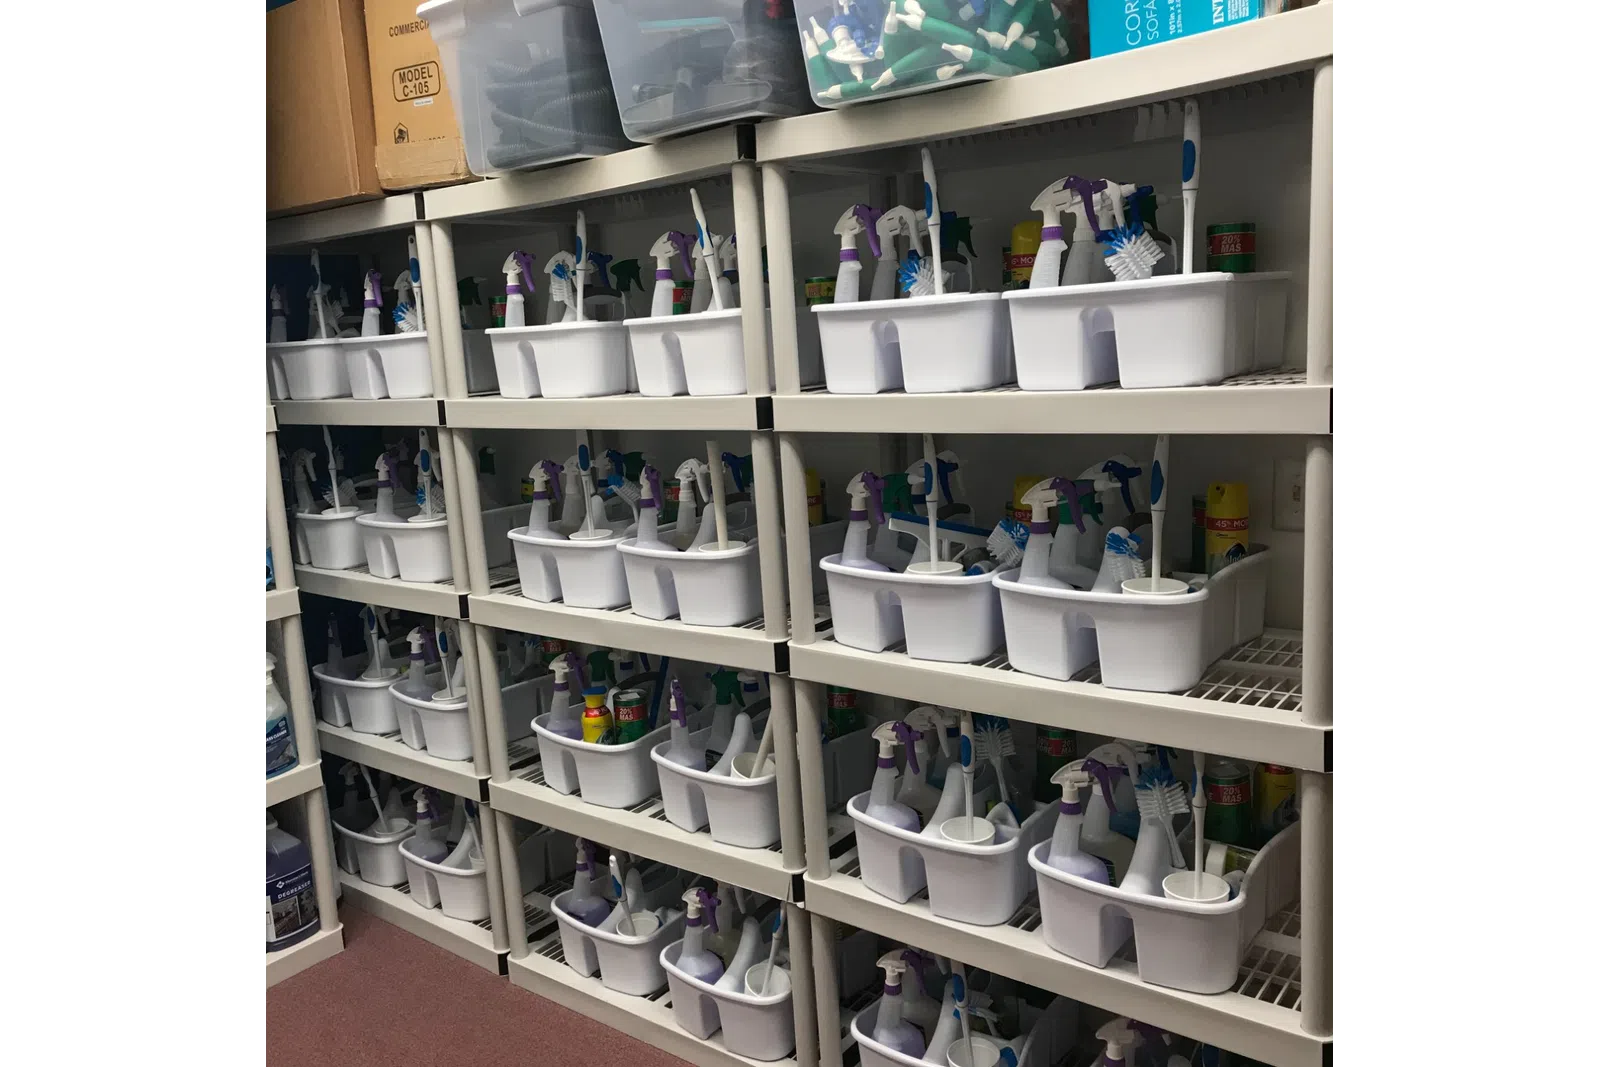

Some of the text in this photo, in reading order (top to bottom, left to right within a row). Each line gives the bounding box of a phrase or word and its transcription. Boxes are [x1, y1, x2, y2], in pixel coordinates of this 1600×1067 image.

[1125, 0, 1142, 45] COR
[398, 66, 433, 84] MODEL
[402, 81, 430, 97] C-105
[1221, 235, 1241, 245] 20%
[1220, 243, 1242, 253] MAS
[1020, 257, 1037, 265] MO
[619, 707, 633, 715] 20%
[1223, 787, 1241, 795] 20%
[1222, 794, 1242, 803] MAS
[278, 881, 311, 899] DEGREASER
